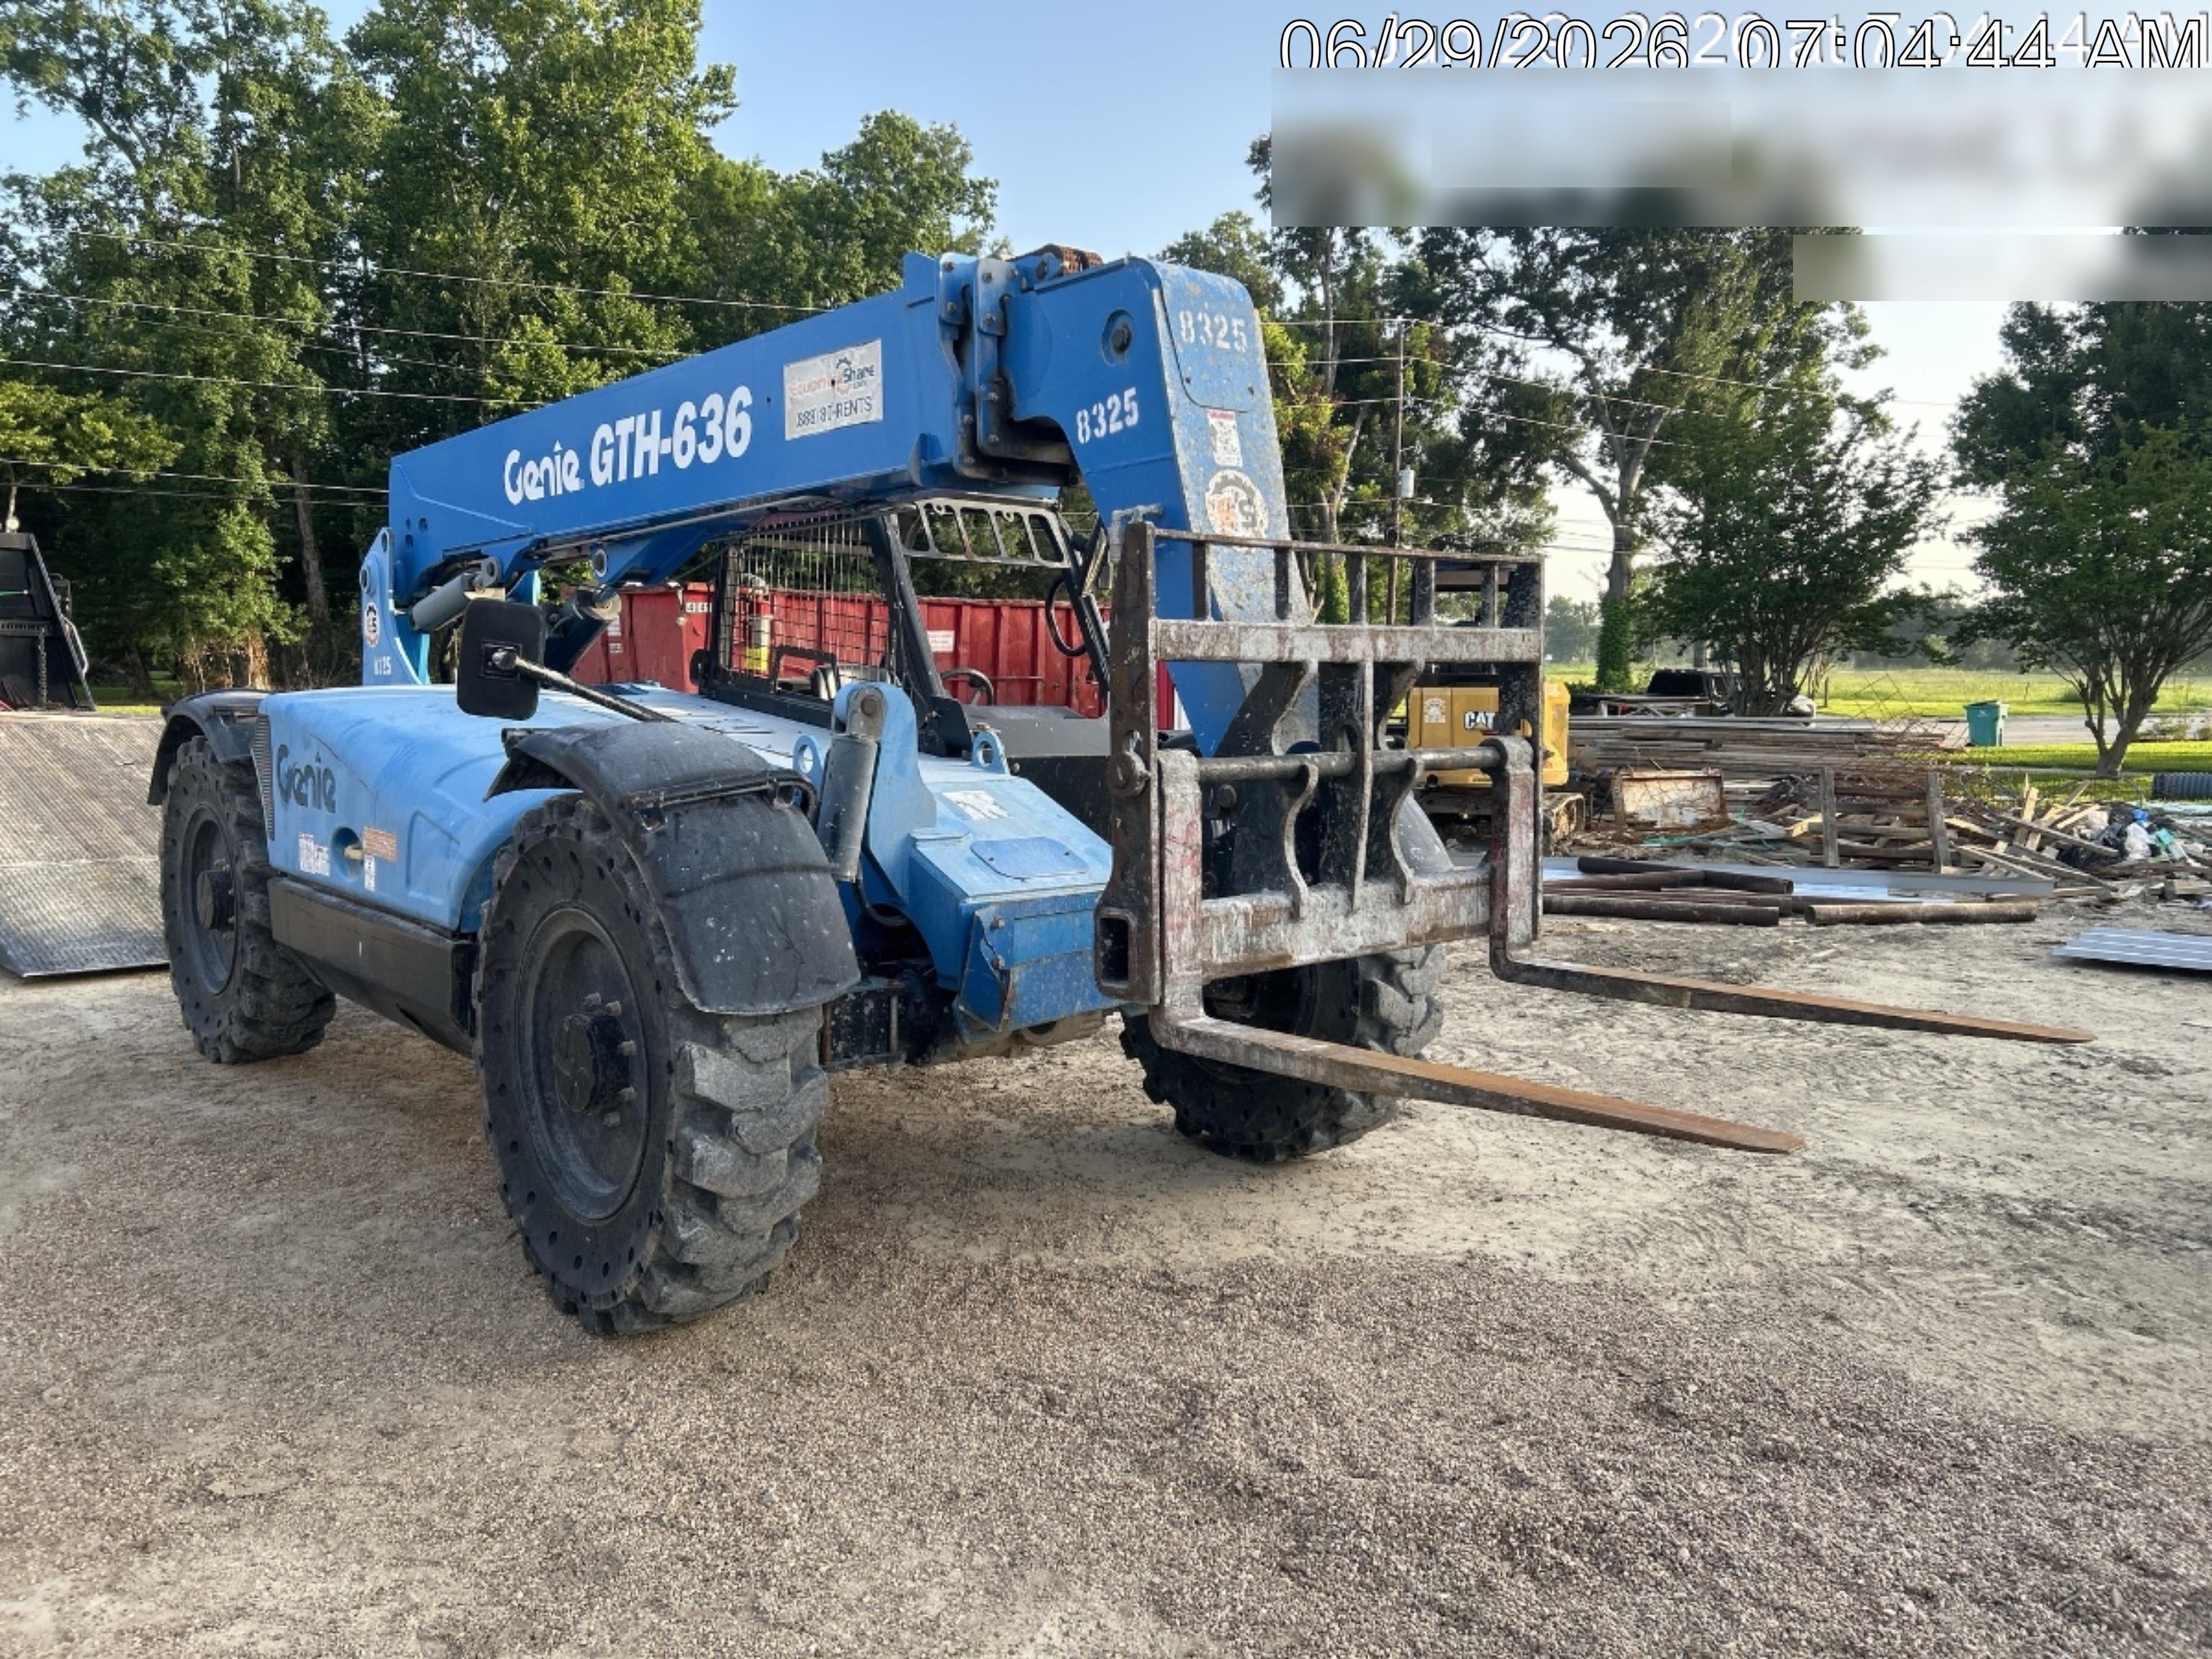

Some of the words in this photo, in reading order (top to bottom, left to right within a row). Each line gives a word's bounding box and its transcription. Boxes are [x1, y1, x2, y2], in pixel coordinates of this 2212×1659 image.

[1179, 310, 1247, 353] 8325
[1076, 387, 1139, 444] 8325
[504, 441, 581, 506] Genie
[590, 385, 753, 487] GTH-636
[1464, 711, 1496, 731] CAT
[278, 744, 336, 814] Genie
